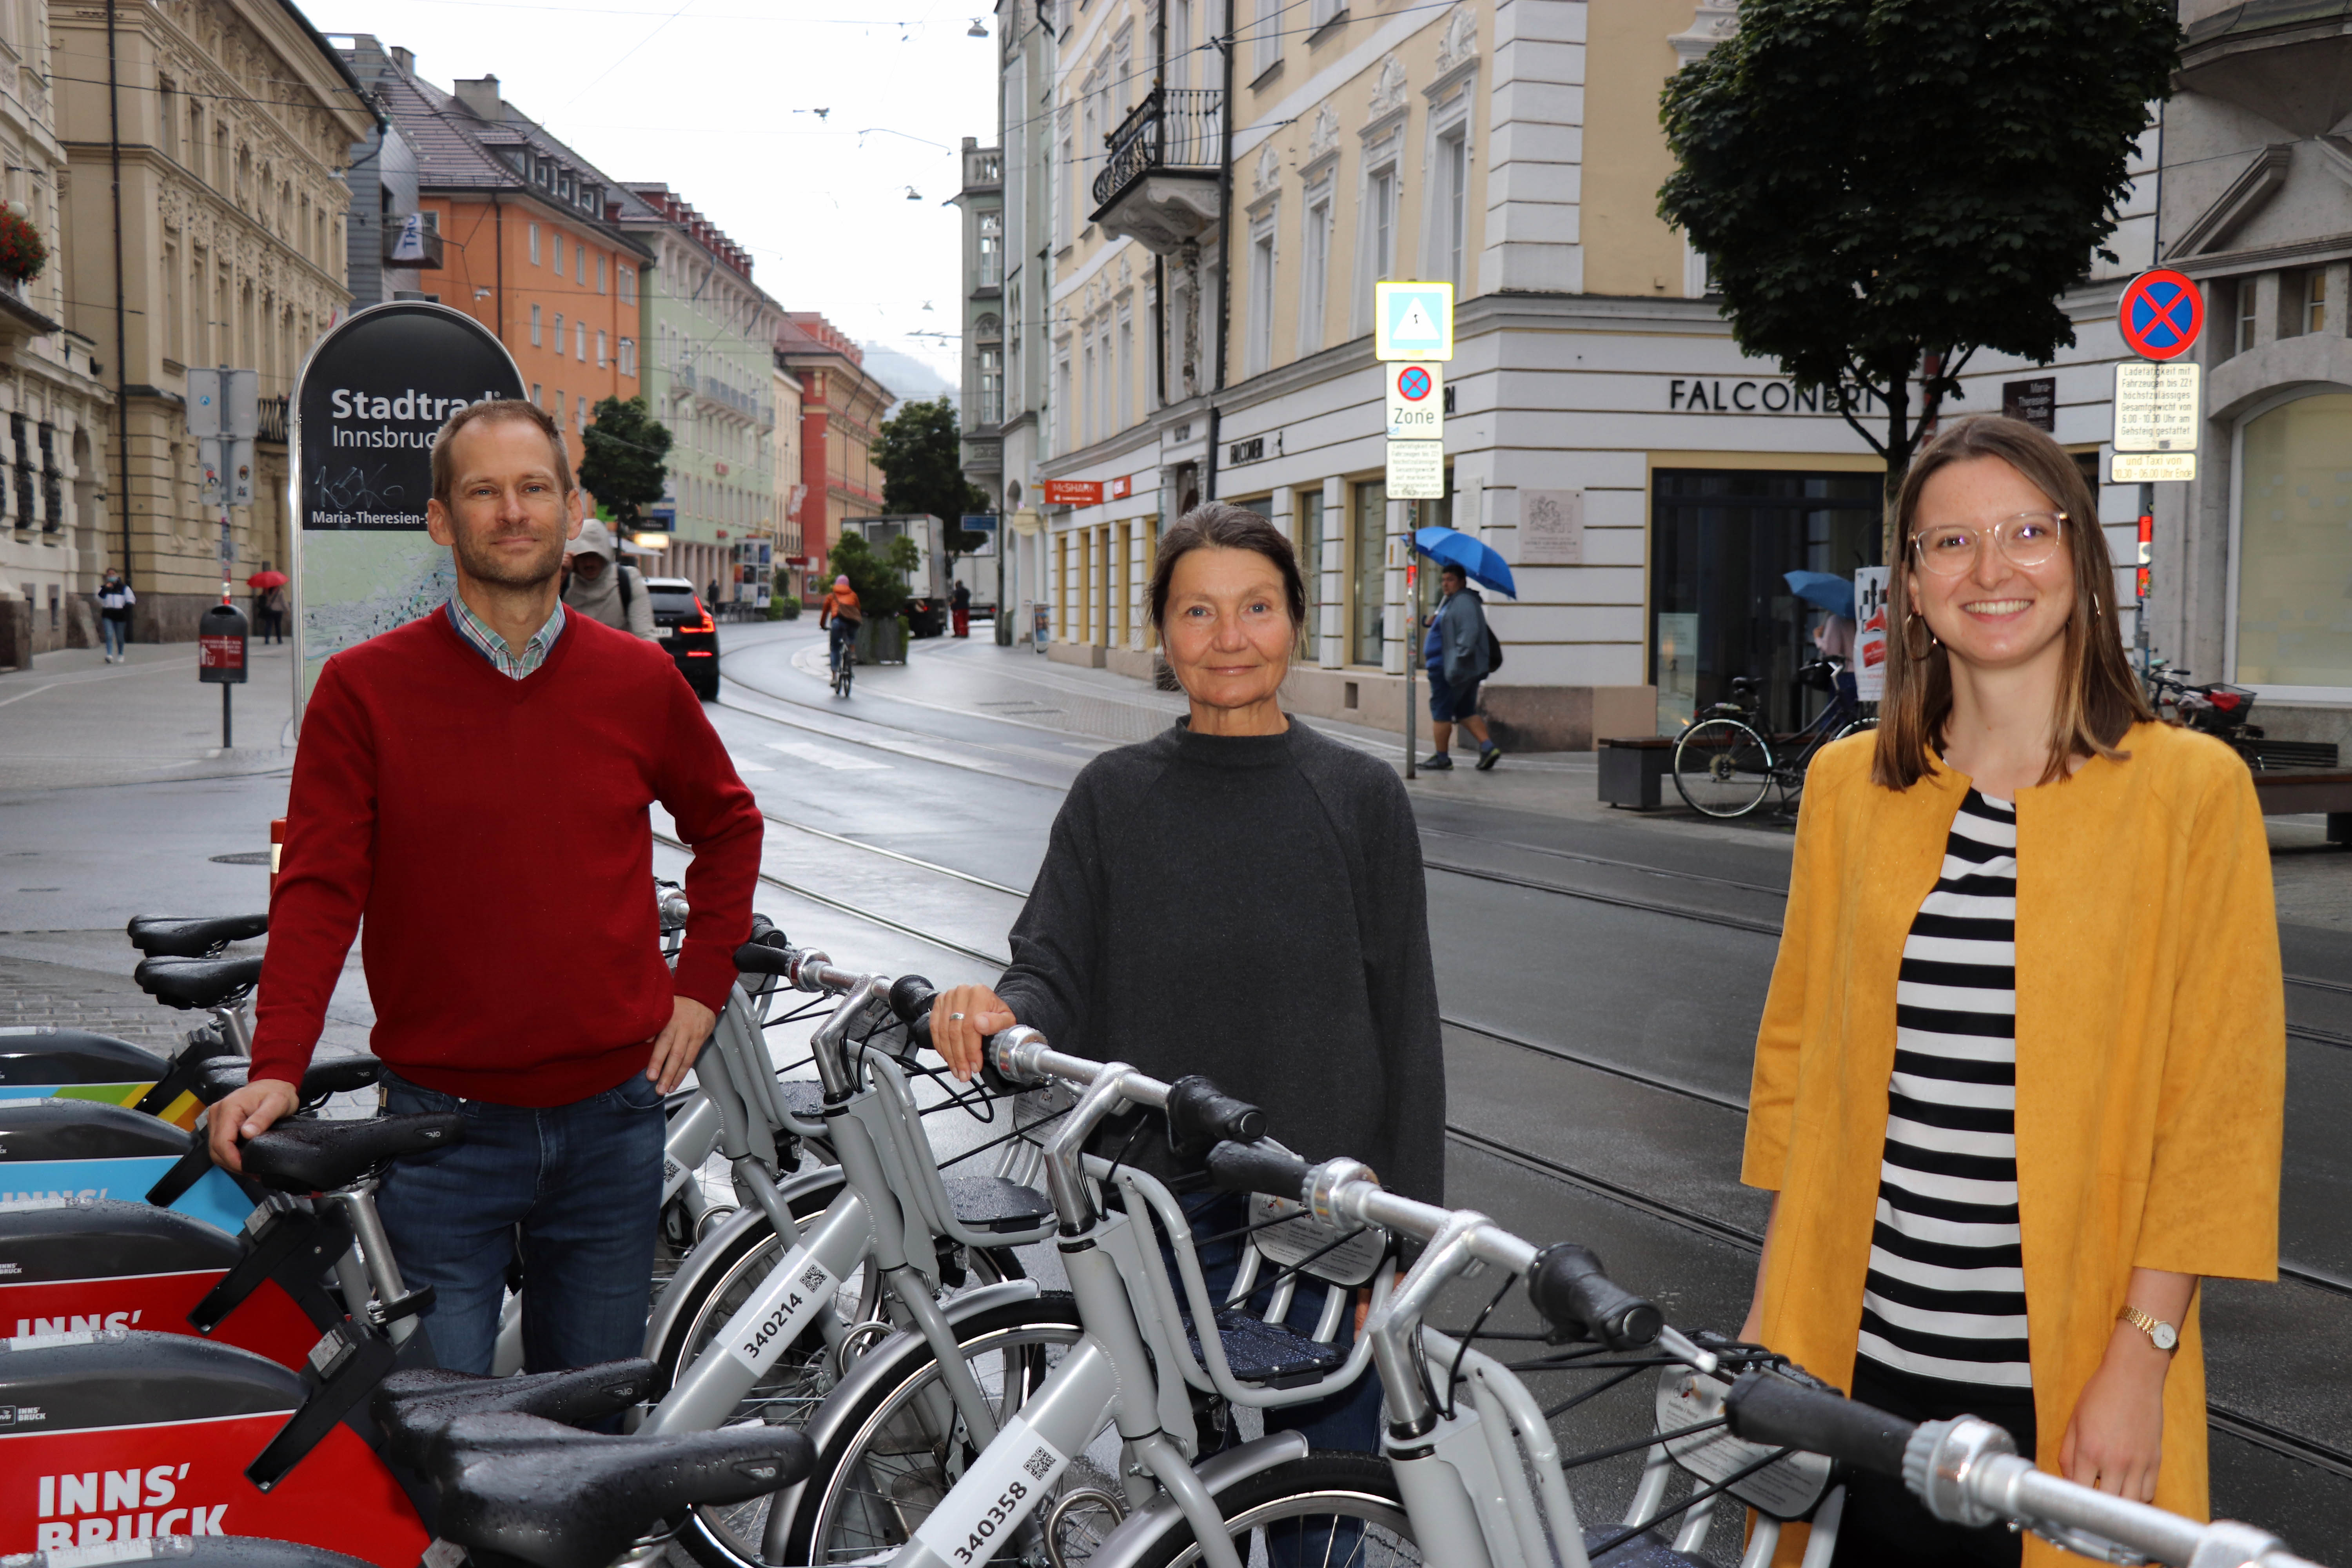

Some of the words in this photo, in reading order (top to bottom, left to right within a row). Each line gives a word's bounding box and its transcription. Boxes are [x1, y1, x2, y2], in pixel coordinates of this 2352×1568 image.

[2178, 367, 2190, 375] mit
[2122, 379, 2164, 389] Fahrzeugen
[2167, 379, 2177, 387] bis
[2121, 403, 2176, 413] Gesamtgewicht
[1394, 408, 1434, 424] Zone
[2163, 414, 2176, 423] Uhr
[333, 424, 442, 448] Innsbruc
[2121, 426, 2153, 437] Gehsteig
[2156, 426, 2190, 437] gestattet
[2126, 456, 2142, 465] und
[2145, 455, 2163, 465] Taxi
[2160, 468, 2173, 477] Uhr
[2176, 468, 2192, 478] Ende
[743, 1292, 804, 1358] 340214
[18, 1406, 41, 1415] INNS'
[18, 1412, 46, 1421] BRUCK
[38, 1462, 191, 1518] INNS'
[953, 1481, 1028, 1565] 340358
